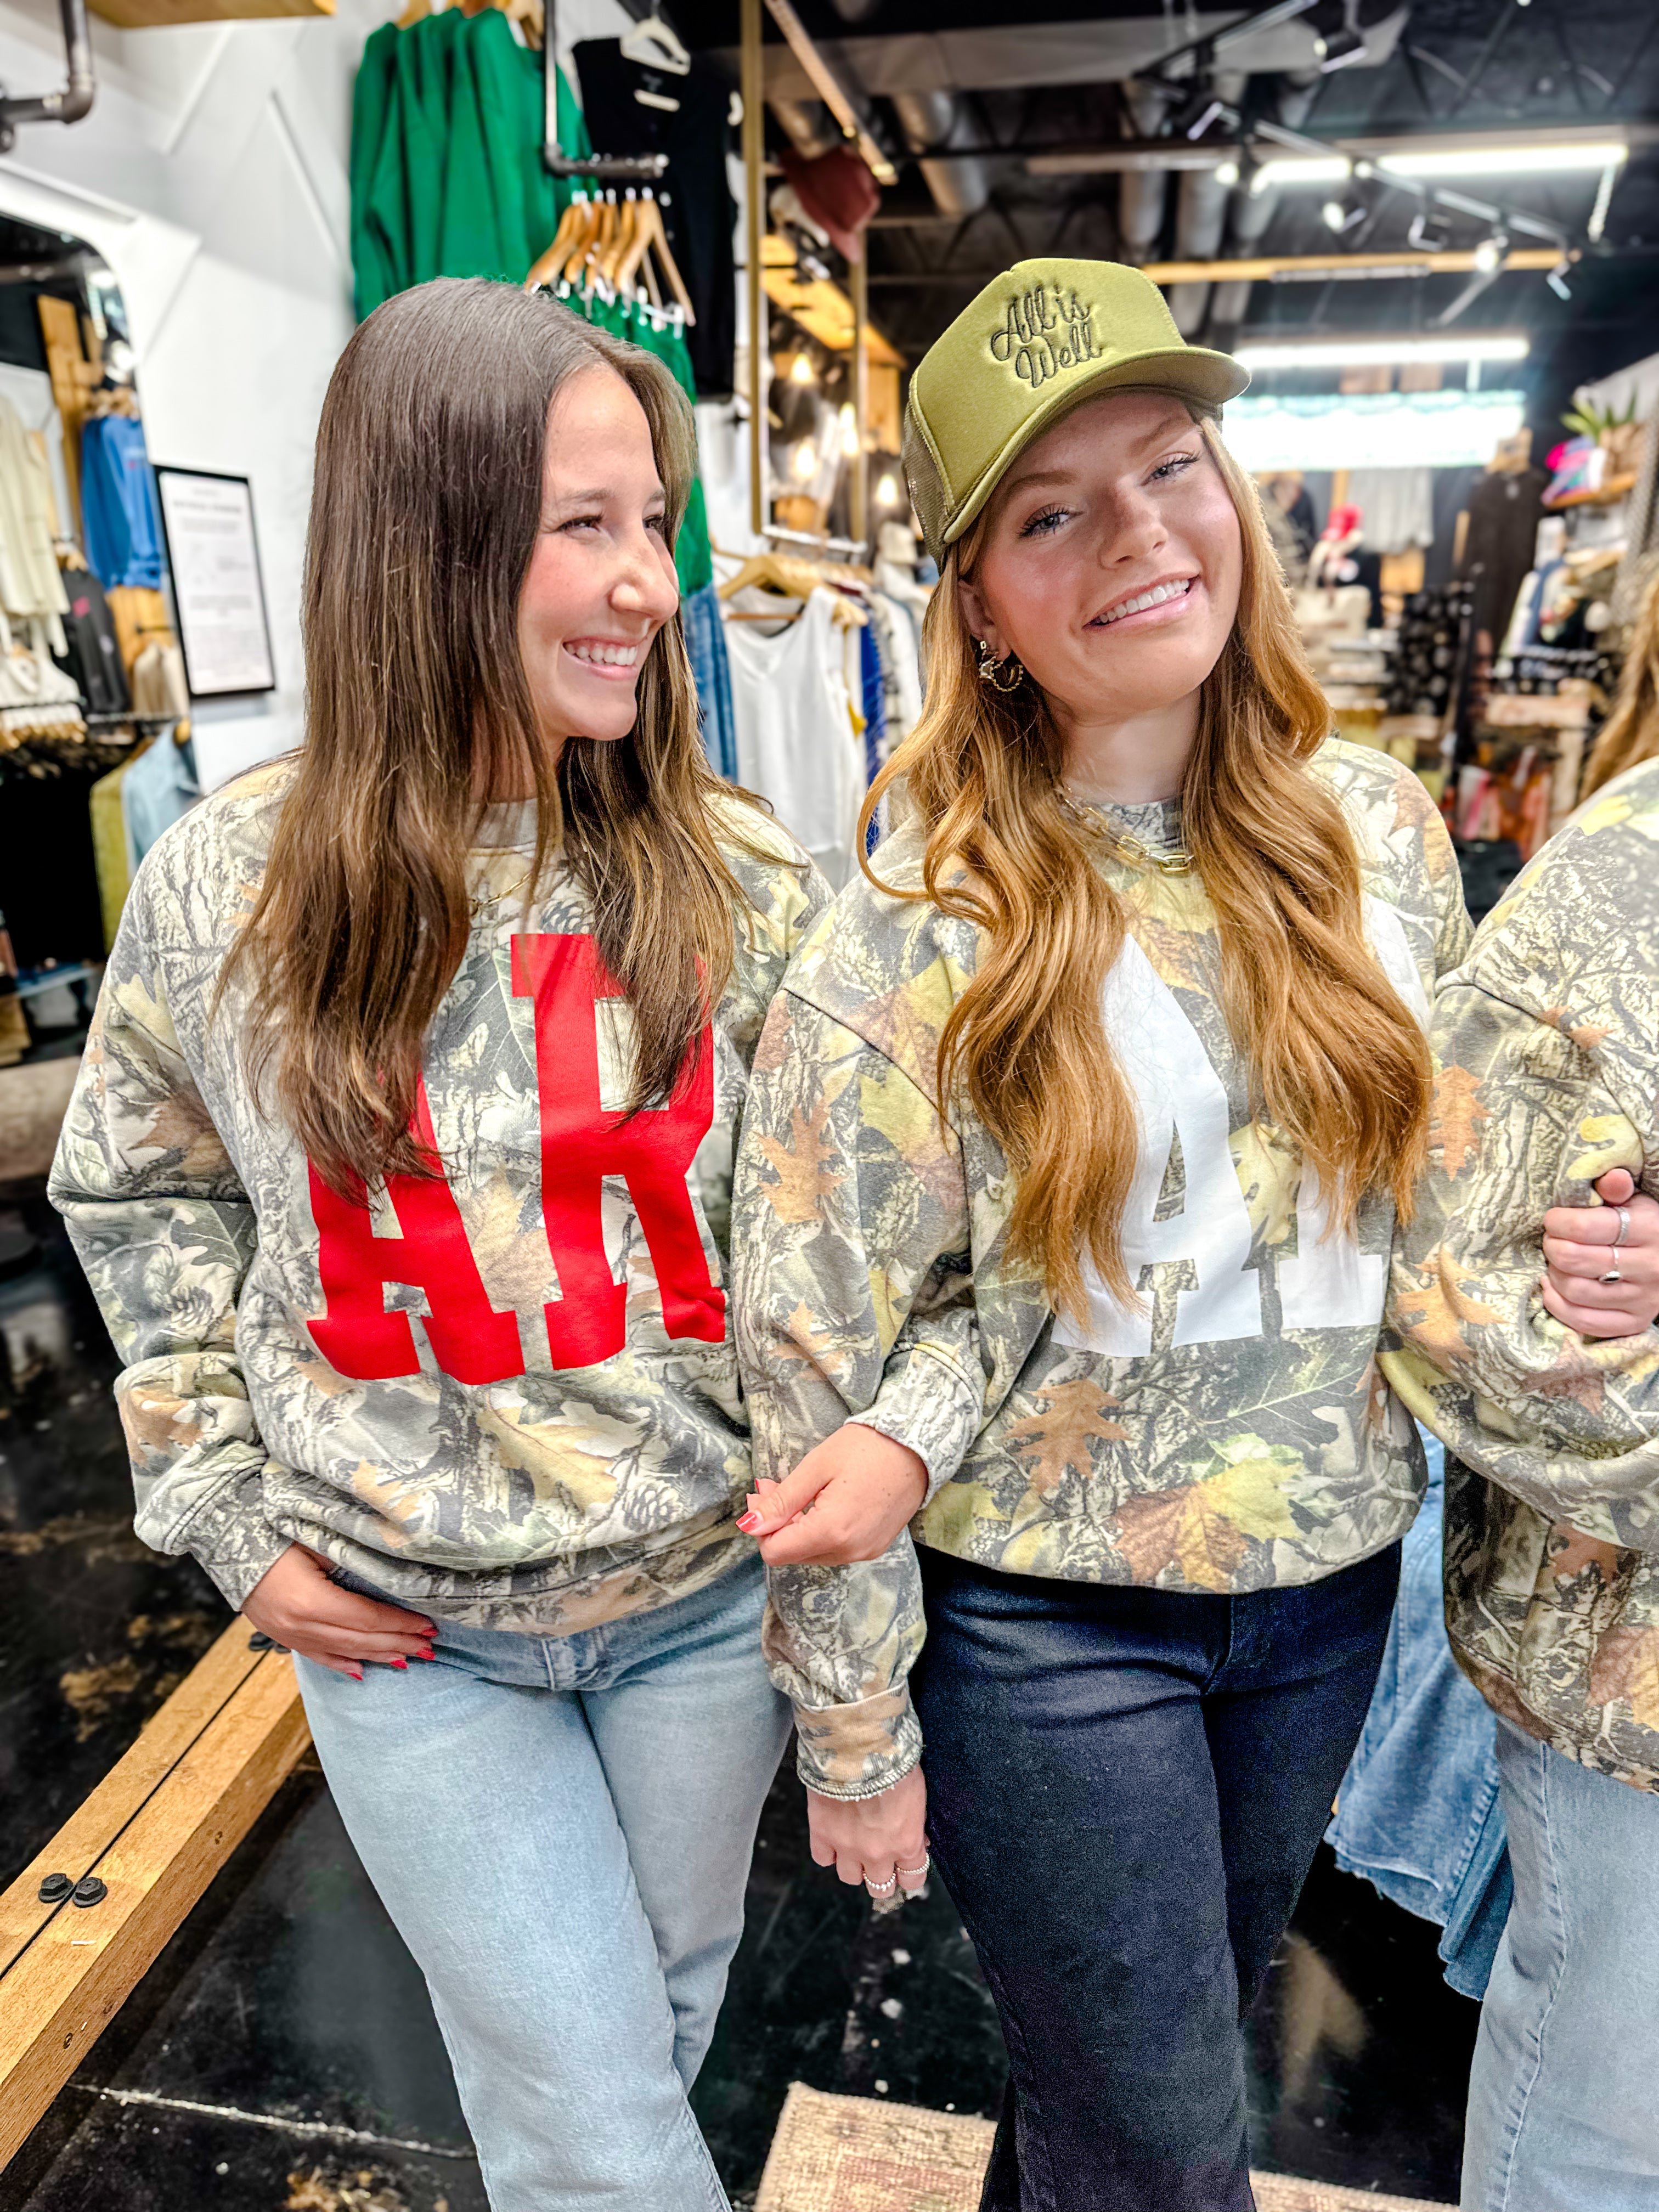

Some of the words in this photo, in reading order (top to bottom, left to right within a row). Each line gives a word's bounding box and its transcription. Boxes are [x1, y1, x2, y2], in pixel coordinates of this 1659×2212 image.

[991, 283, 1056, 362] All
[1053, 282, 1091, 324] is
[1015, 322, 1103, 388] Well
